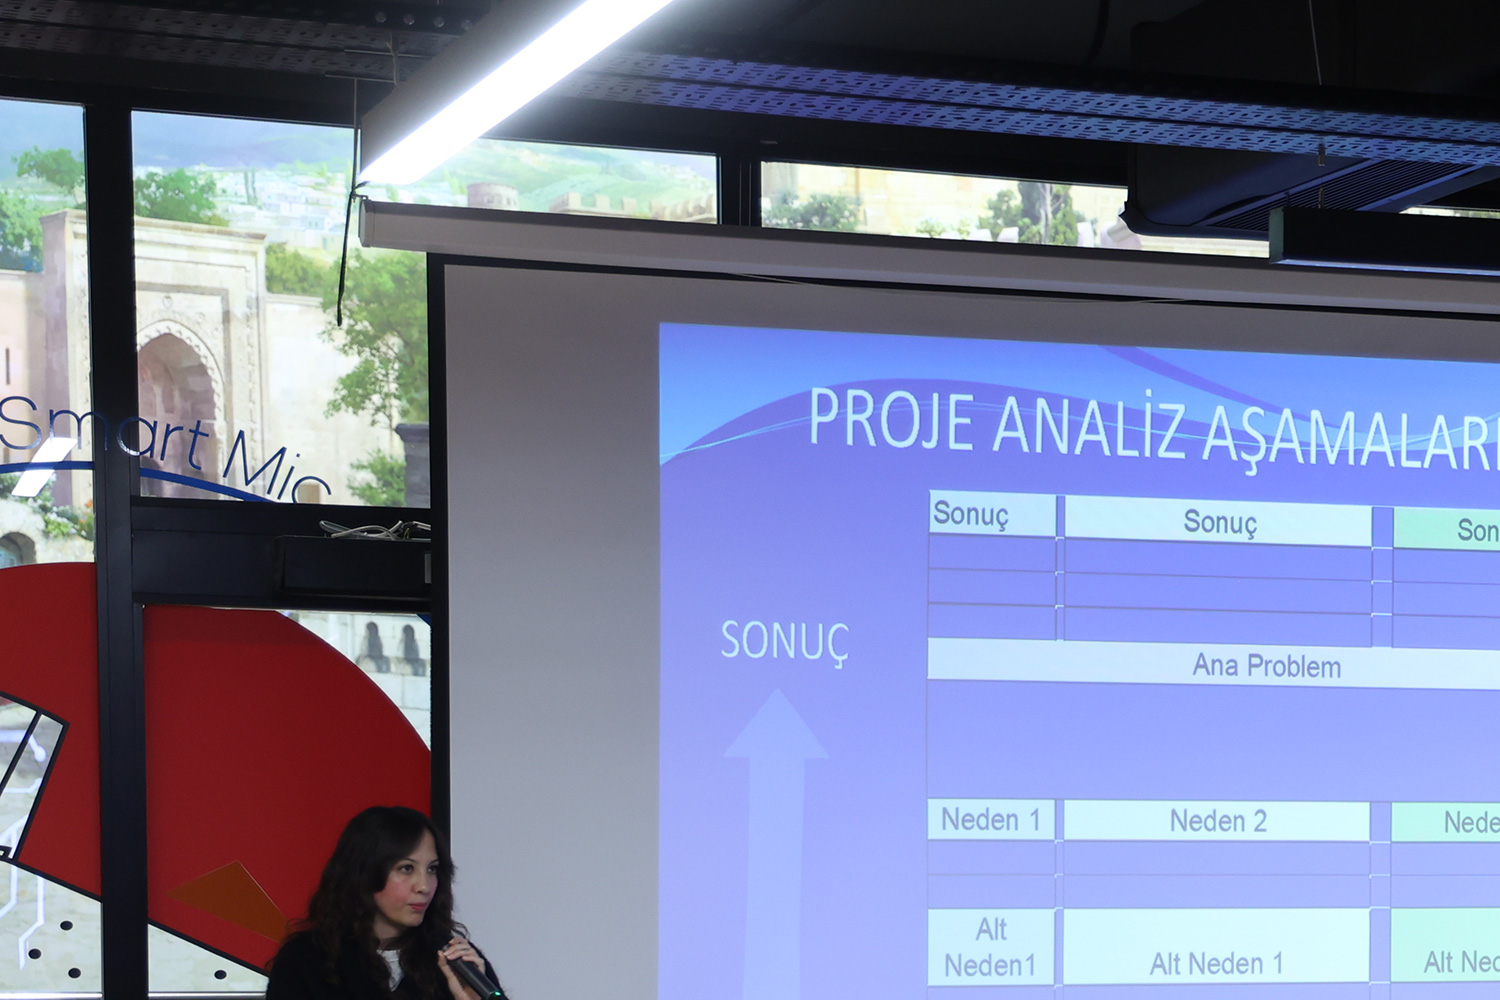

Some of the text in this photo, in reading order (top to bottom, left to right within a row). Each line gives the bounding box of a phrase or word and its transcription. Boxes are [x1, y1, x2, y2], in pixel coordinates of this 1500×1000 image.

[0, 396, 209, 470] Smart
[811, 386, 974, 451] PROJE
[993, 388, 1186, 460] ANALİZ
[934, 500, 1009, 531] Sonuç
[1184, 508, 1258, 540] Sonuç
[721, 619, 849, 669] SONUÇ
[1193, 651, 1341, 679] Ana Problem
[942, 806, 1040, 831] Neden 1
[1170, 807, 1267, 832] Neden 2
[975, 916, 1008, 941] Alt
[1149, 950, 1283, 976] Alt Neden 1
[1423, 950, 1454, 974] Alt
